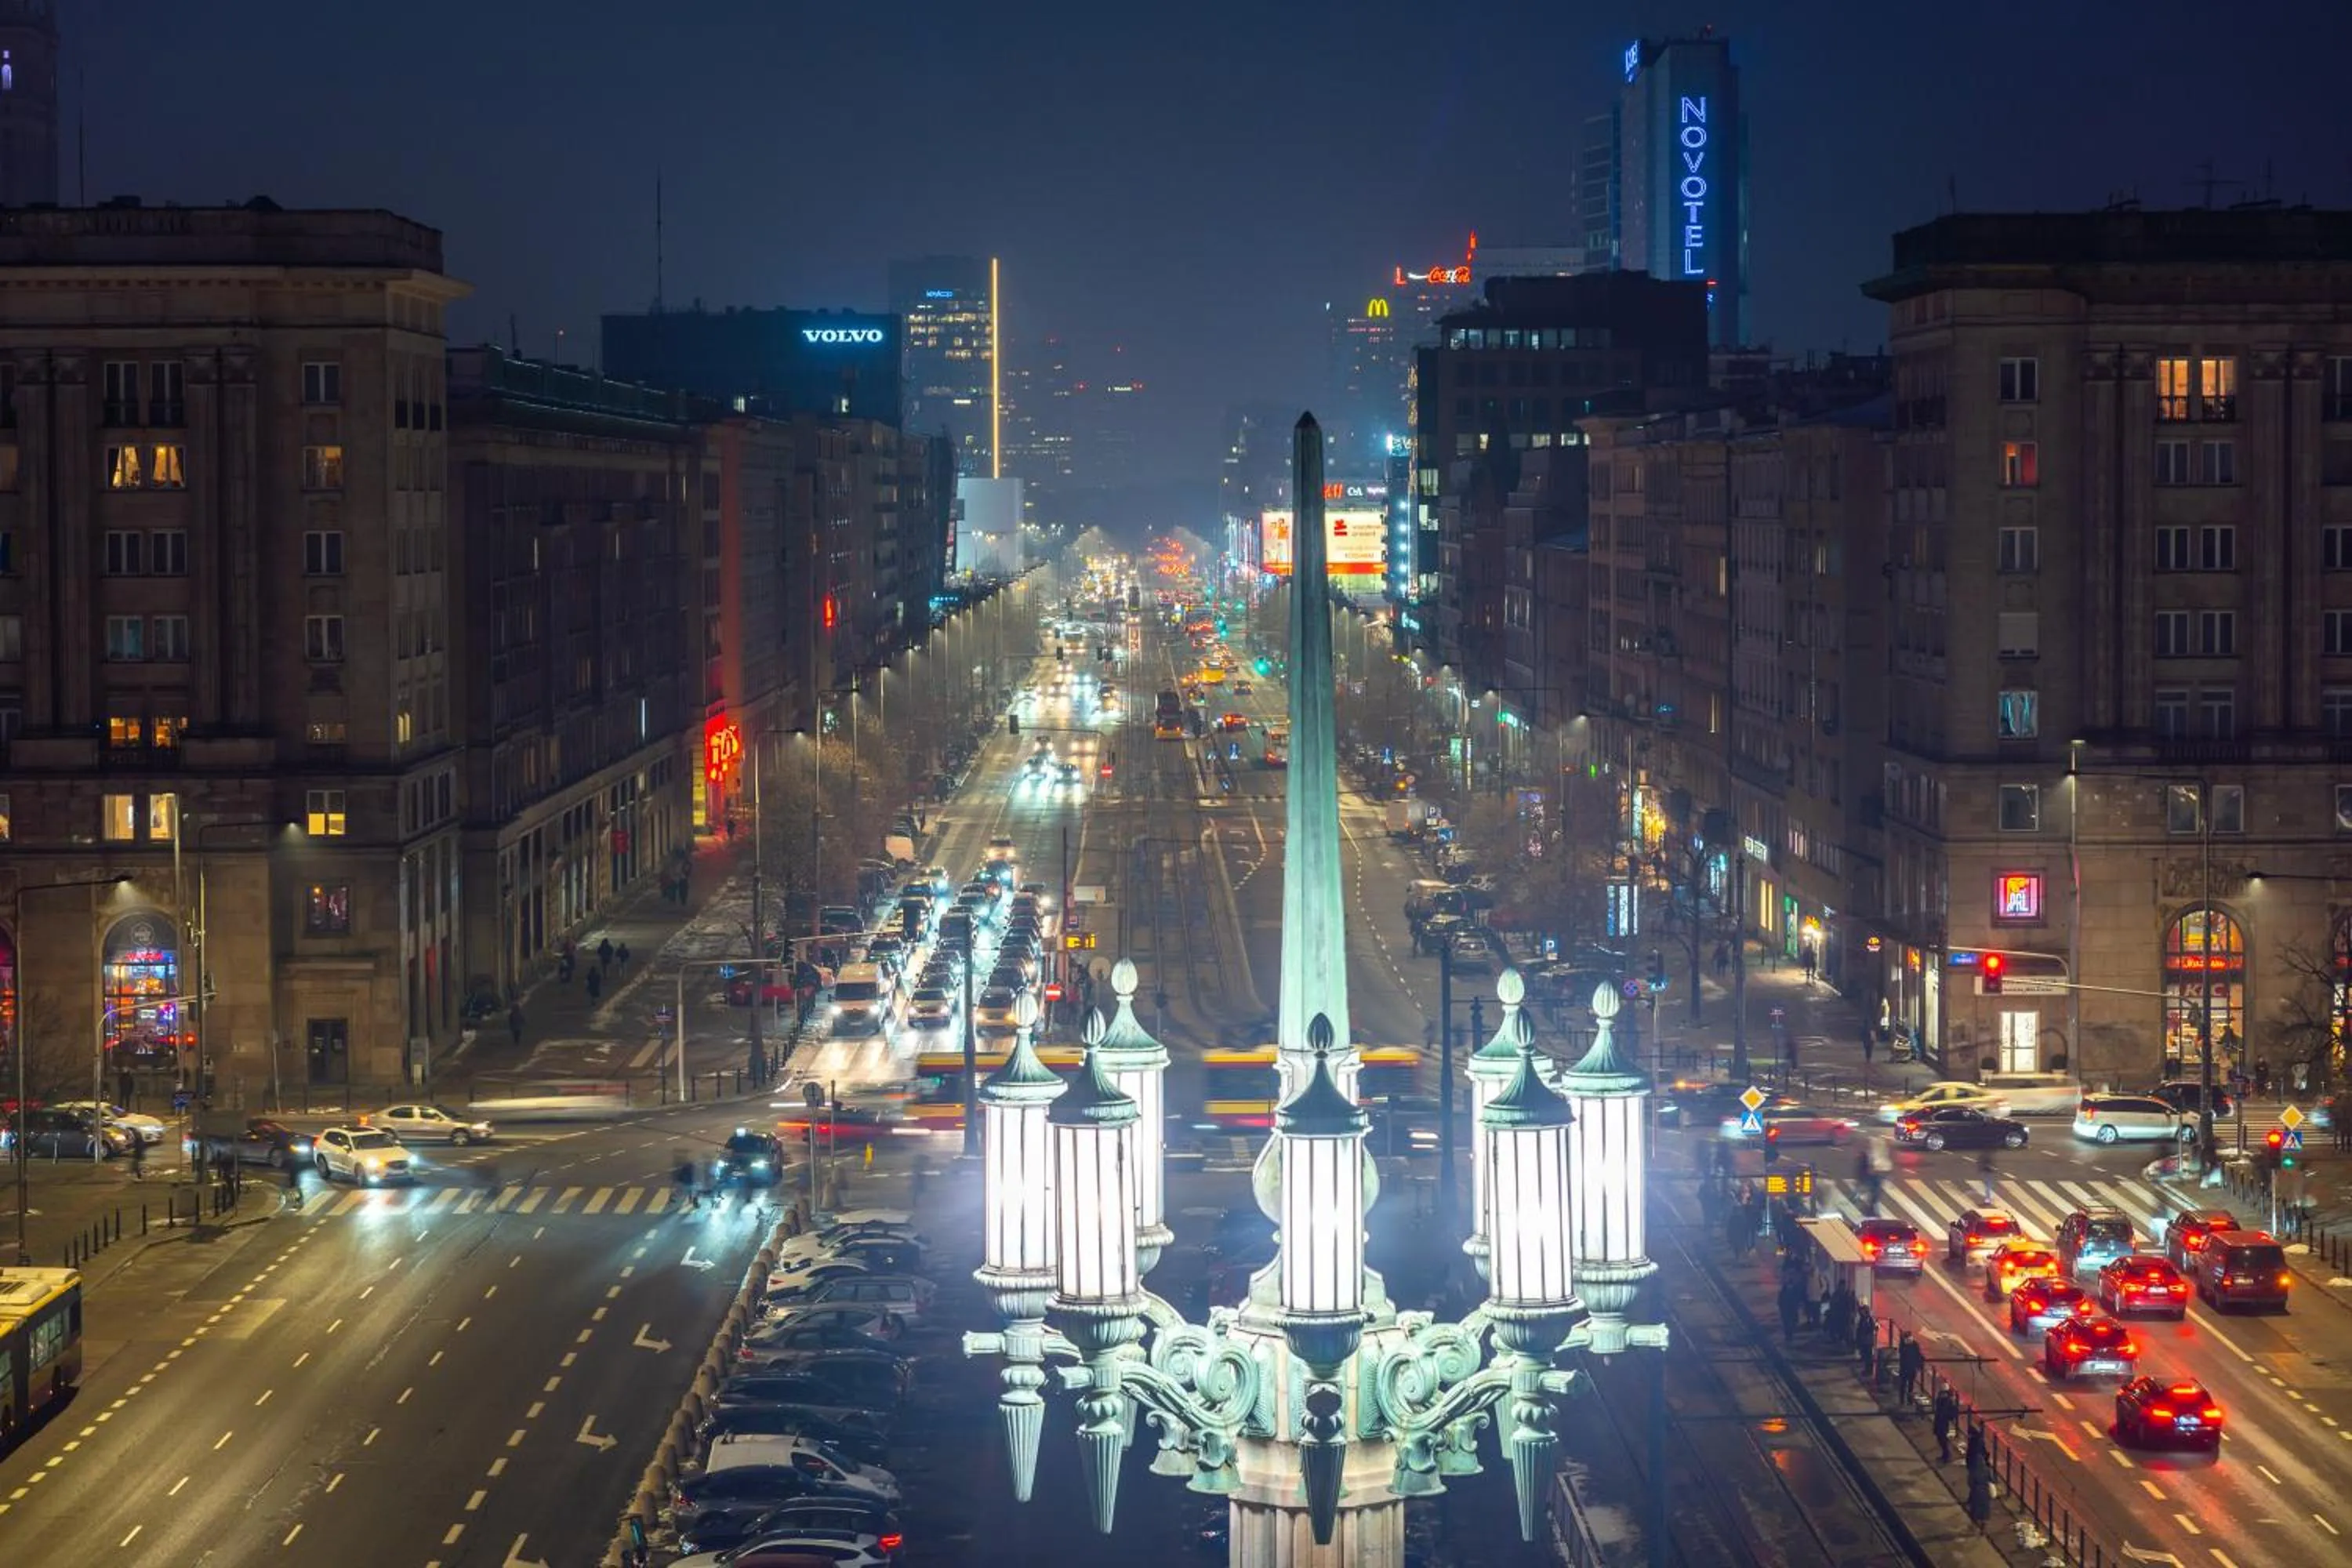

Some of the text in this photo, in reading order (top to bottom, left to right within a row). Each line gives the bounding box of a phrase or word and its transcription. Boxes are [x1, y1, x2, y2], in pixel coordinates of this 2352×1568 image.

[1680, 96, 1707, 274] NOVOTEL
[803, 329, 883, 343] VOLVO
[2183, 983, 2225, 996] KC
